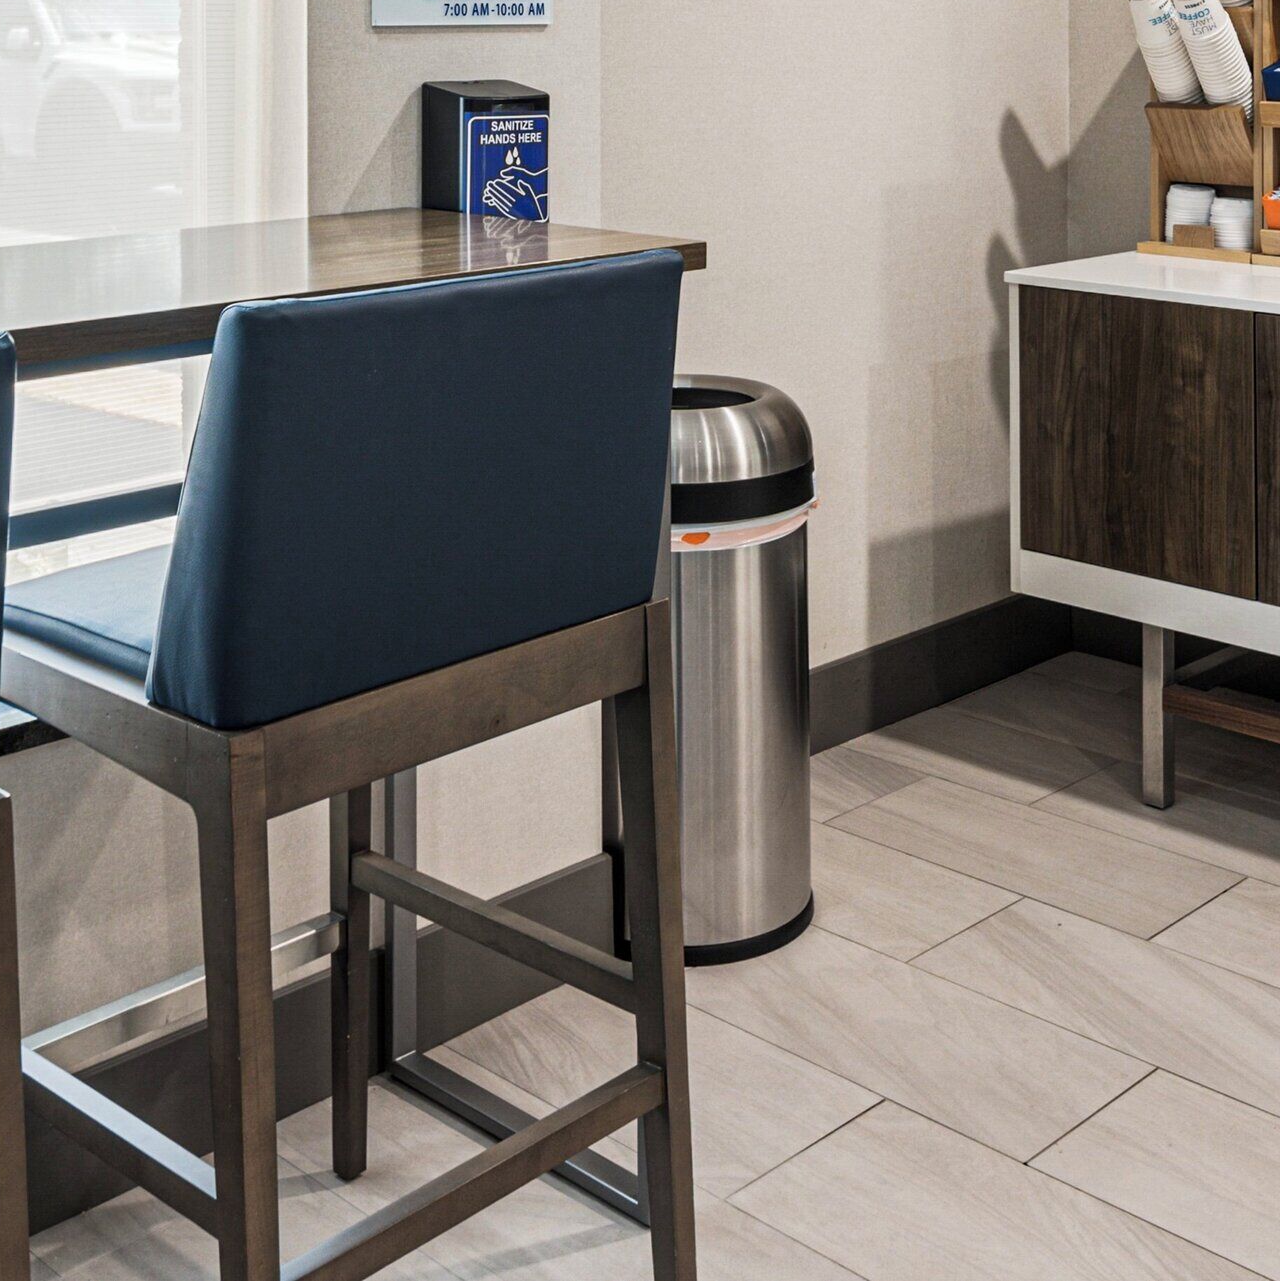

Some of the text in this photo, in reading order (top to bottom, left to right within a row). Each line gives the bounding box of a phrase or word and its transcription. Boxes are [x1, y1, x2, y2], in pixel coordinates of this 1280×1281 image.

[443, 3, 468, 16] 7:00
[528, 3, 545, 16] AM
[1191, 14, 1214, 28] HAVE
[1192, 22, 1218, 36] MUST
[491, 120, 534, 132] SANITIZE
[480, 132, 542, 145] HANDS HERE
